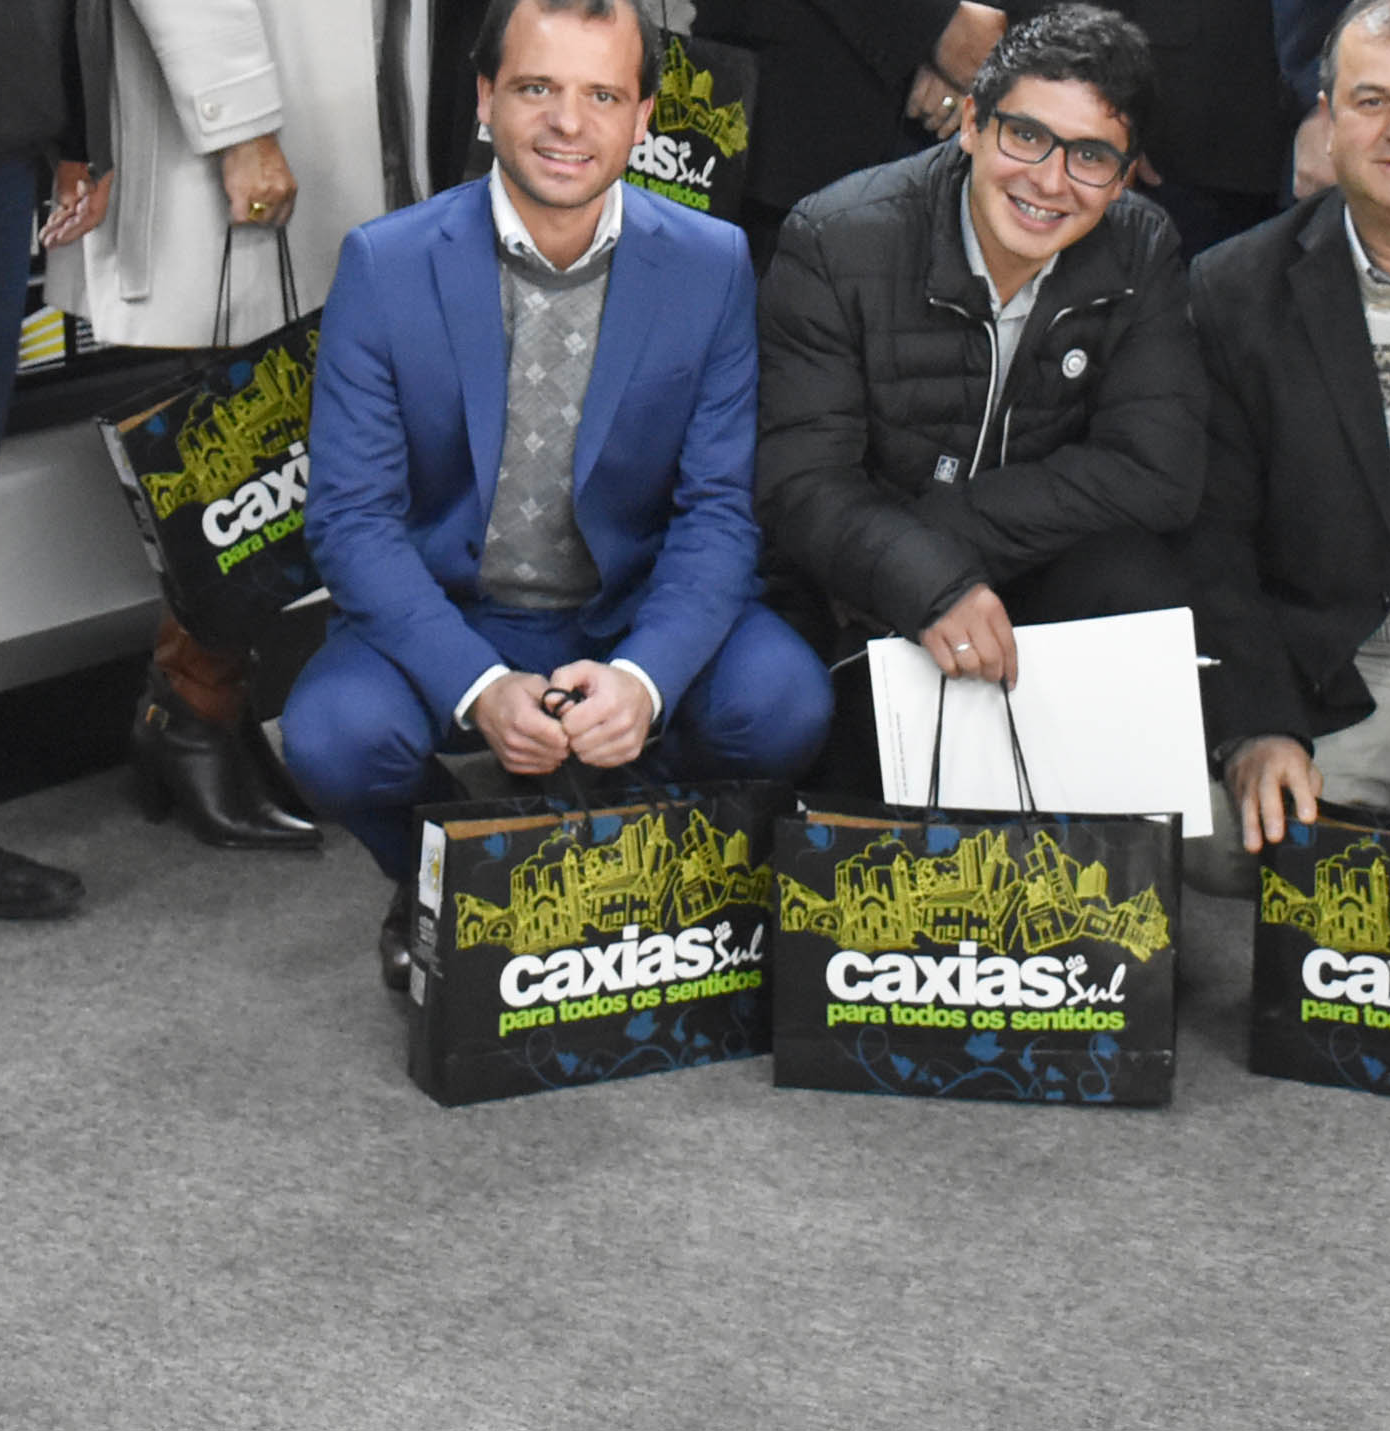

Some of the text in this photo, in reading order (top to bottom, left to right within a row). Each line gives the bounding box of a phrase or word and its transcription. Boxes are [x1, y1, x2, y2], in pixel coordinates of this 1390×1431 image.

[677, 152, 716, 188] Sul
[216, 533, 265, 574] para
[498, 923, 717, 1008] caxias
[714, 924, 764, 971] Sul
[825, 940, 1068, 1006] caxias
[1066, 961, 1127, 1006] Sul
[499, 968, 762, 1036] para todos os sentidos
[826, 999, 1125, 1032] para todos os sentidos
[1301, 996, 1362, 1024] para
